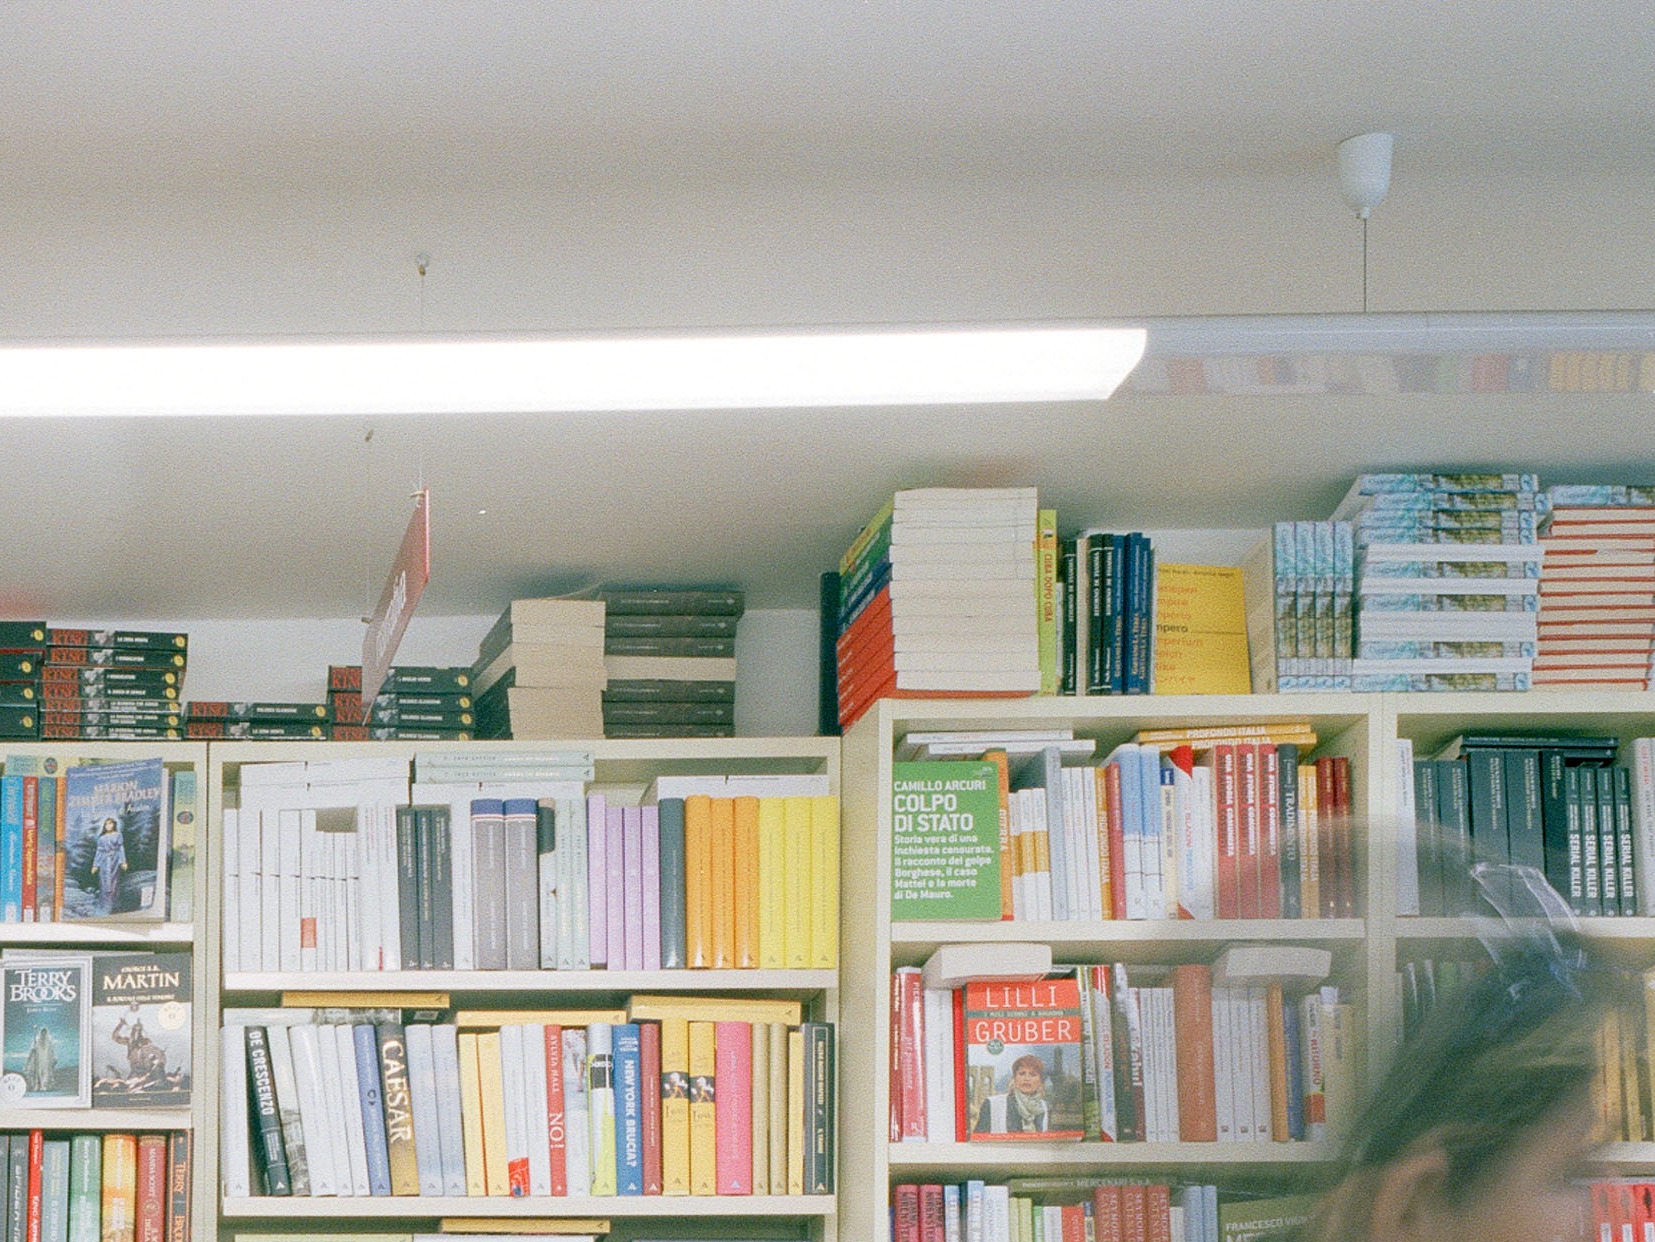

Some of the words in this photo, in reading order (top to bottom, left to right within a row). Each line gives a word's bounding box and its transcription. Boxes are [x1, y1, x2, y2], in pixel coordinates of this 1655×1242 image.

[1187, 727, 1236, 739] PROFONDO
[1238, 726, 1266, 736] ITALIA
[894, 780, 942, 791] CAMILLO
[944, 780, 986, 791] ARCURI
[894, 794, 957, 812] COLPO
[894, 814, 912, 832] DI
[917, 813, 973, 832] STATO
[999, 808, 1009, 850] GUERRA
[1286, 789, 1296, 861] TRADIMENTO
[948, 856, 962, 865] del
[965, 857, 992, 867] golpe
[1569, 833, 1580, 865] SERIAL
[1585, 834, 1596, 866] SERIAL
[1603, 834, 1614, 865] SERIAL
[1621, 833, 1631, 864] SERIAL
[894, 868, 944, 879] Borghese,
[894, 878, 926, 887] Mattei
[1571, 868, 1582, 898] KILLER
[1587, 868, 1598, 899] KILLER
[1605, 868, 1616, 898] KILLER
[1623, 867, 1634, 898] KILLER
[894, 890, 903, 899] di
[905, 890, 919, 899] De
[921, 890, 953, 899] Mauro.
[14, 970, 72, 987] TERRY
[103, 972, 180, 991] MARTIN
[10, 985, 77, 1003] BROOKS
[986, 986, 1057, 1007] LILLI
[249, 1031, 262, 1048] DE
[975, 1020, 1072, 1041] GRUBER
[547, 1034, 557, 1069] SYLVIA
[252, 1049, 275, 1116] CRESCENZO
[382, 1040, 412, 1142] CAESAR
[550, 1072, 560, 1095] HALL
[625, 1083, 636, 1115] YORK
[549, 1112, 563, 1149] NO!
[625, 1119, 638, 1168] BRUCIA?
[174, 1161, 185, 1194] TERRY
[1101, 1193, 1110, 1235] CATENA
[1109, 1193, 1119, 1242] SEYMOUR
[1226, 1217, 1283, 1232] FRANCESCO
